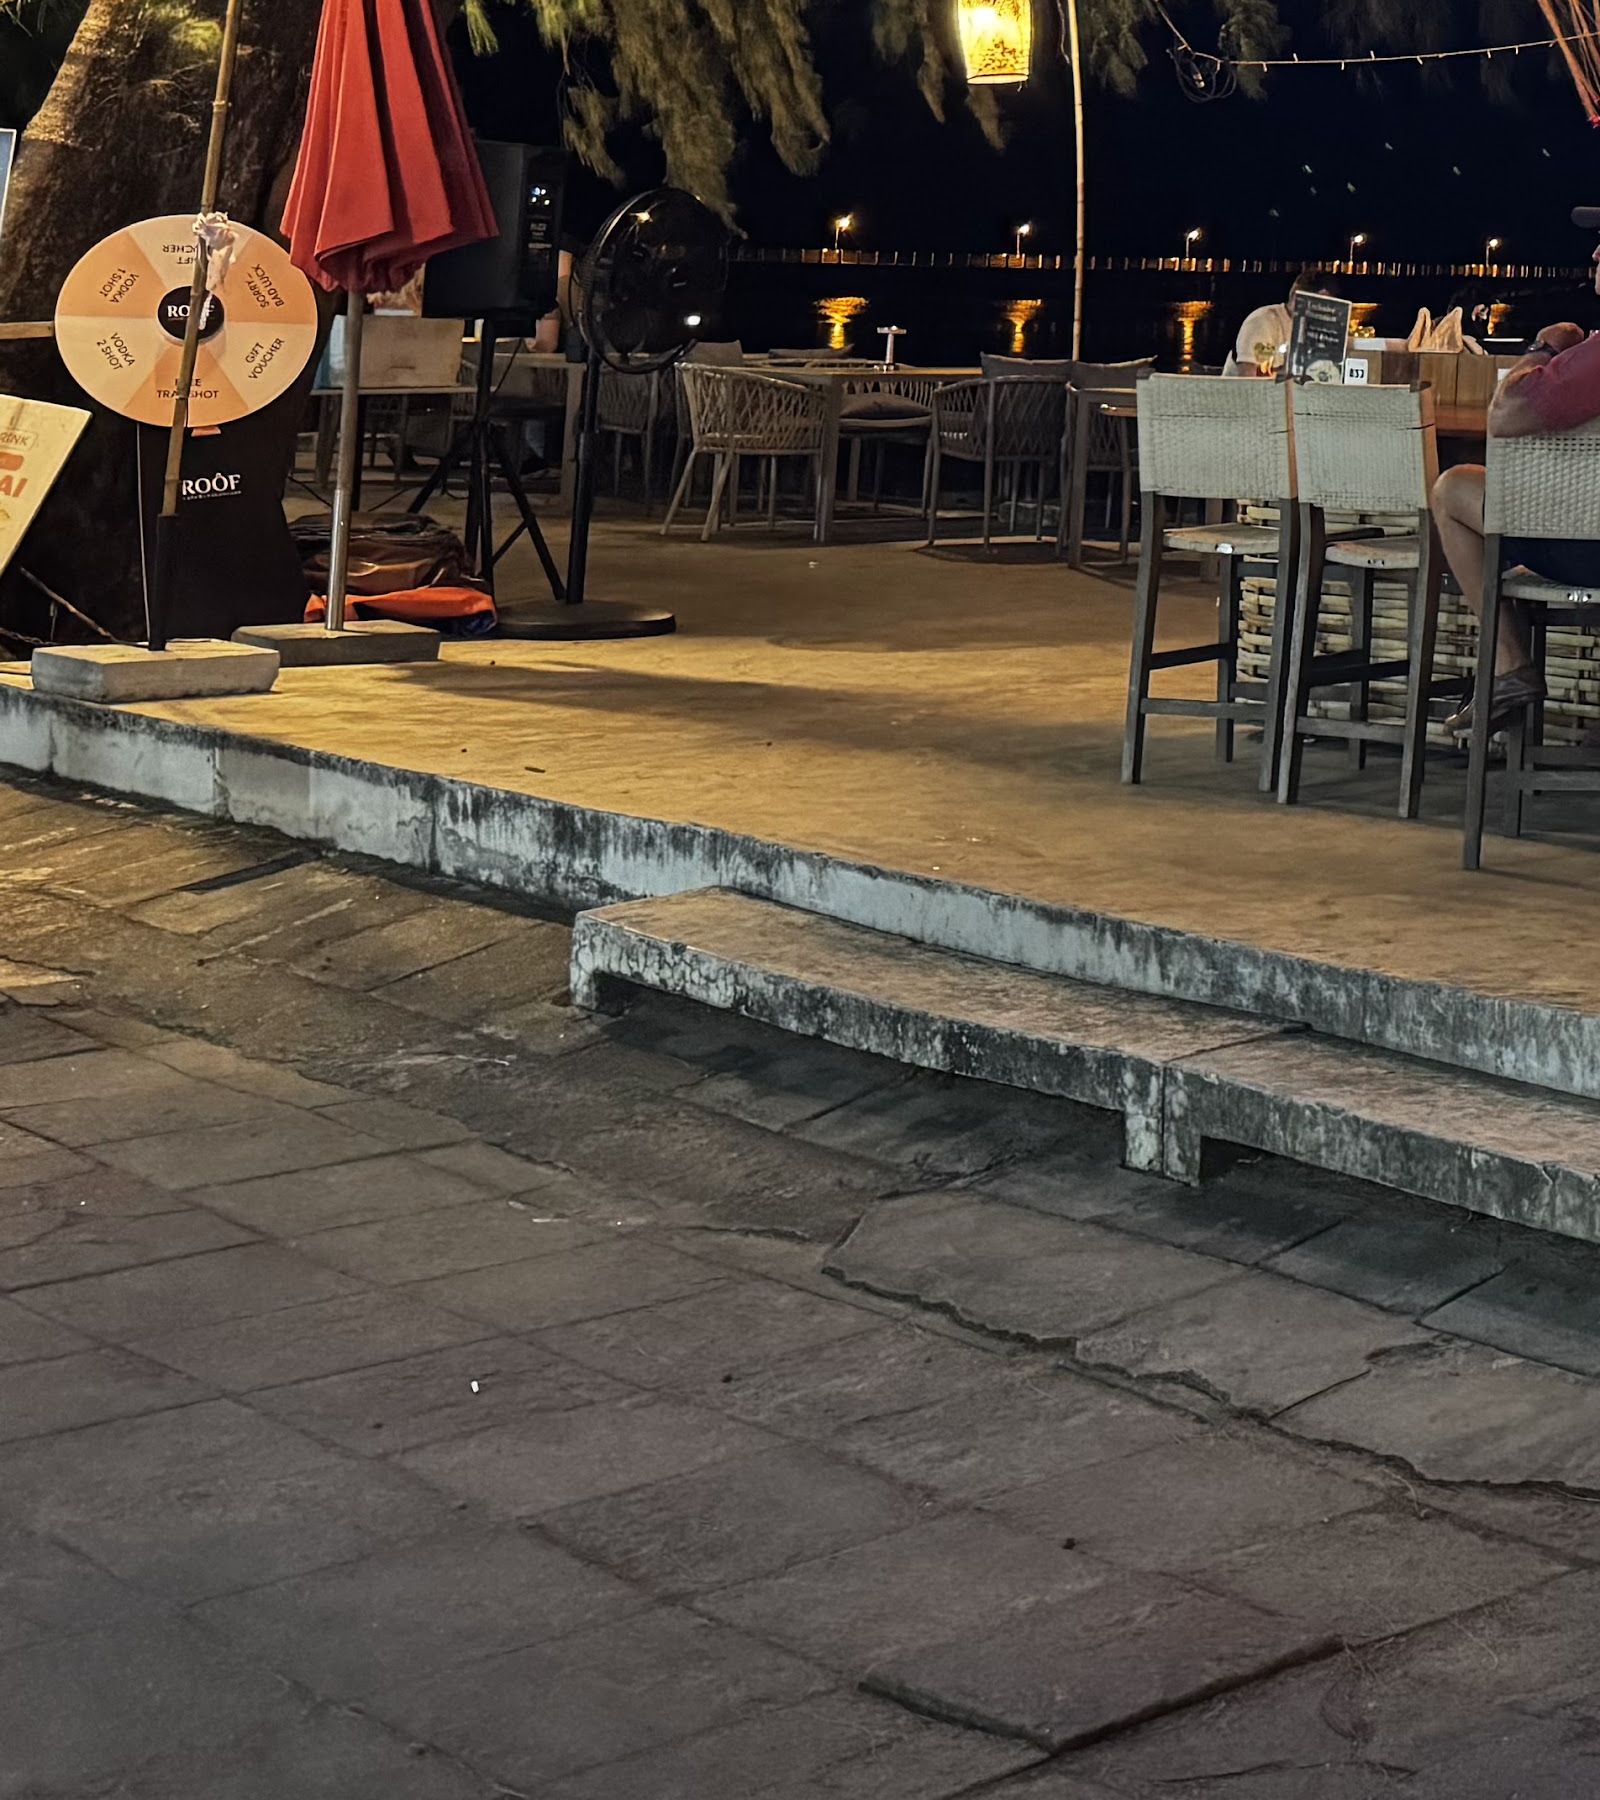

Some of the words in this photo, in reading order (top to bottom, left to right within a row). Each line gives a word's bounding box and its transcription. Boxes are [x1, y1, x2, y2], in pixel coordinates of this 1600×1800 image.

[100, 273, 122, 298] SHOT
[251, 263, 272, 288] LUCK
[109, 273, 140, 303] VODKA
[267, 288, 285, 308] BAD
[167, 305, 215, 318] ROF
[96, 339, 107, 347] 2
[110, 332, 136, 366] VODKA
[245, 342, 264, 363] GIFT
[101, 346, 123, 370] SHOT
[247, 338, 285, 379] VOUCHER
